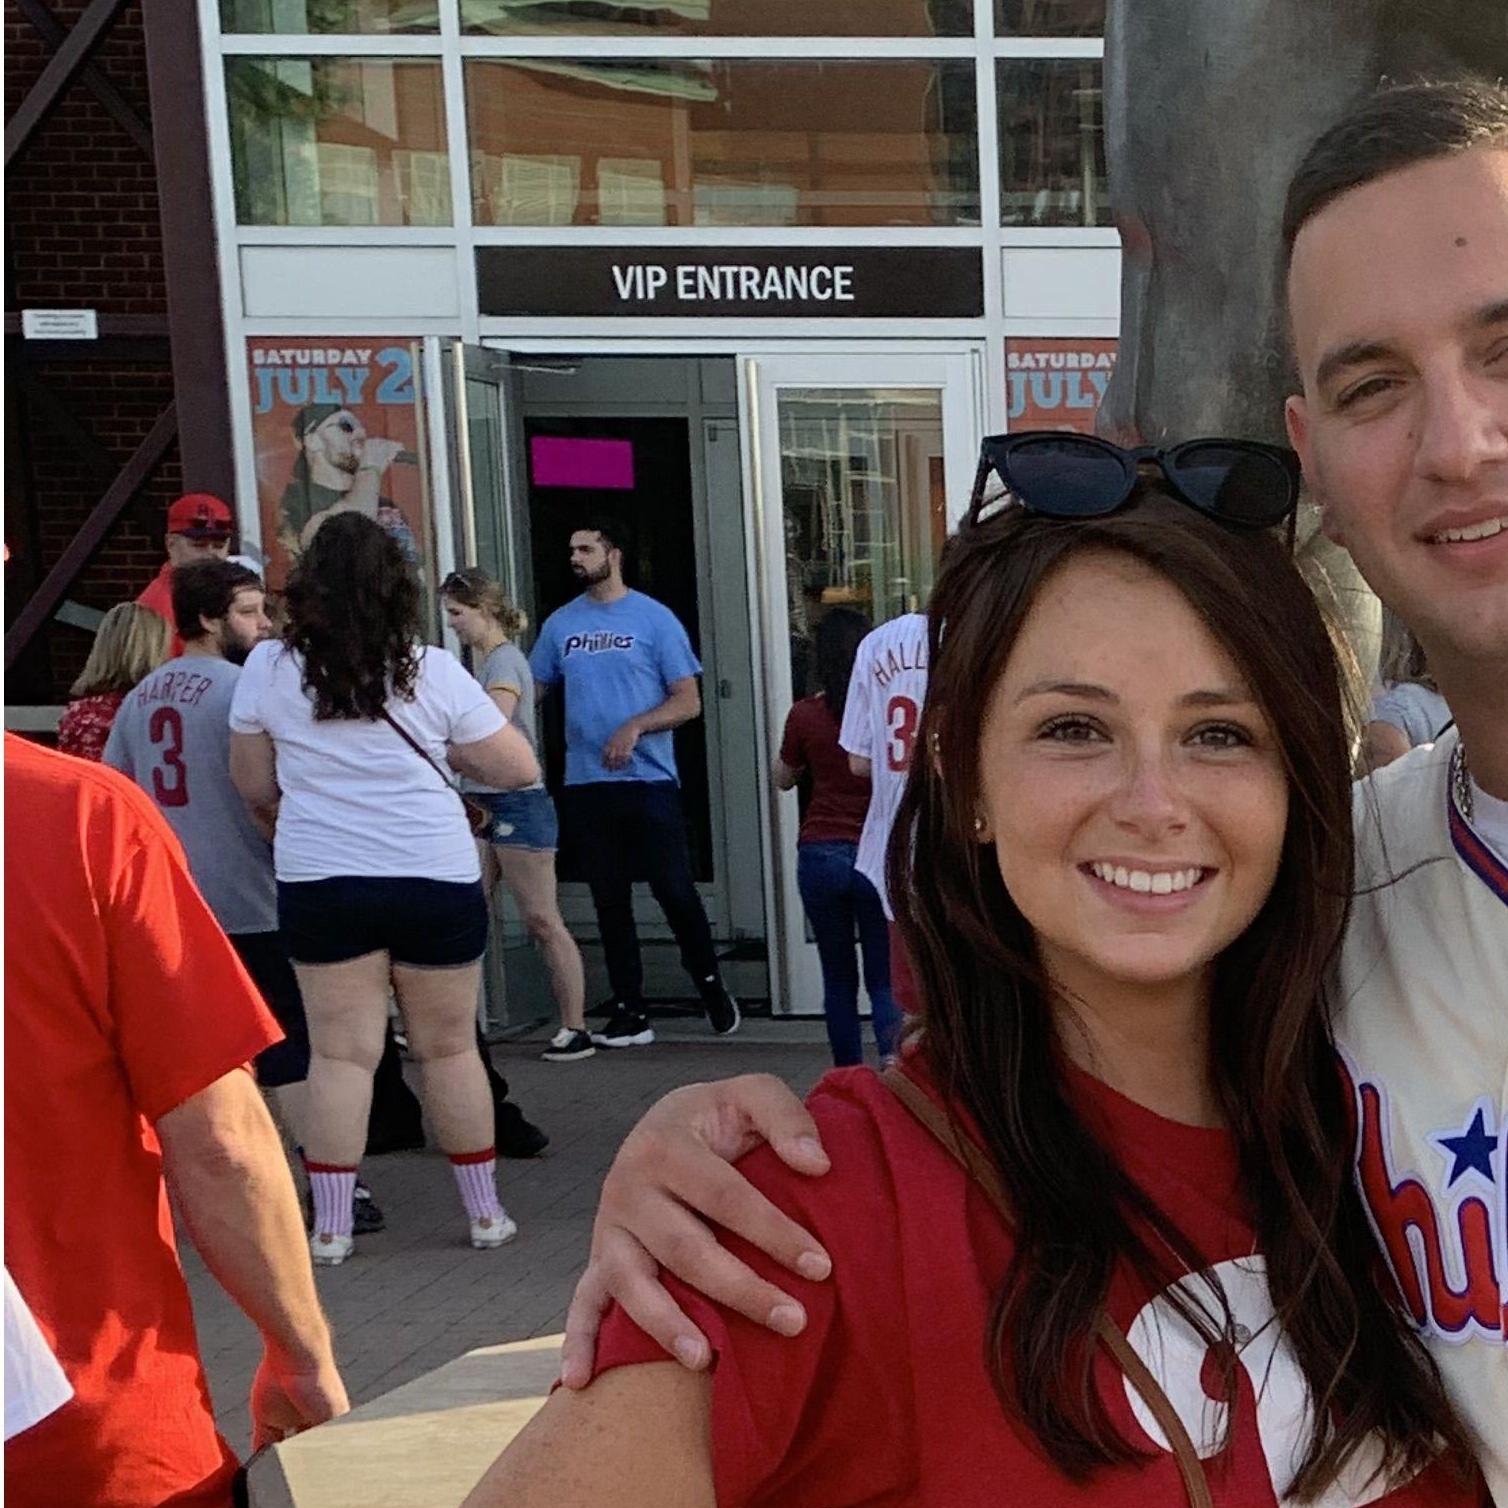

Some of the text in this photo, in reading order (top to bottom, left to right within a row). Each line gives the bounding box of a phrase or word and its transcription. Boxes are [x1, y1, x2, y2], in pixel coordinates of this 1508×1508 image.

[612, 264, 856, 301] VIP ENTRANCE
[253, 349, 372, 365] SATURDAY
[255, 347, 416, 414] JULY 2
[874, 640, 927, 687] HALL
[149, 706, 190, 808] 3
[886, 694, 918, 773] 3
